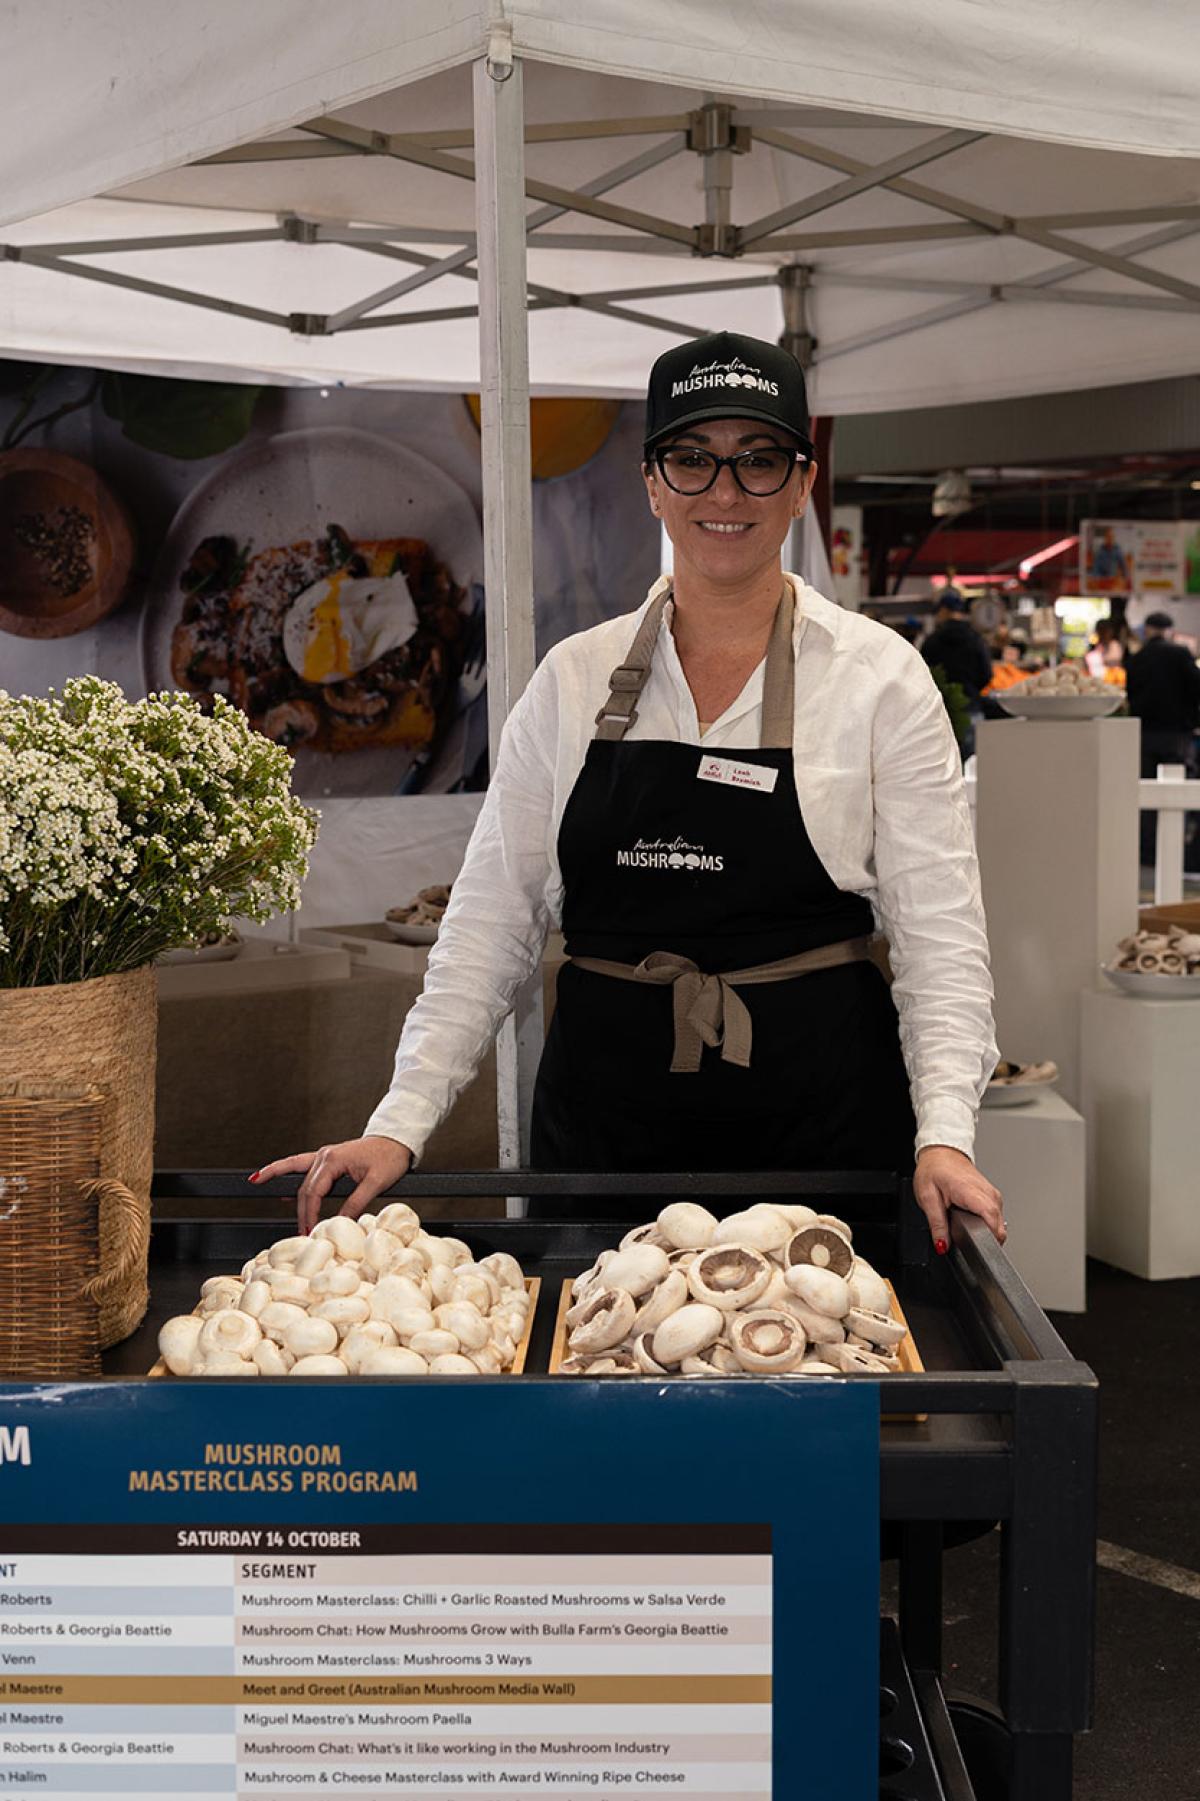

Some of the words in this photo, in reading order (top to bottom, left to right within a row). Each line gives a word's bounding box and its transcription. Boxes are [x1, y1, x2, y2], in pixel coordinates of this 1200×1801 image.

[205, 1444, 341, 1465] MUSHROOM
[129, 1470, 293, 1492] MASTERCLASS
[301, 1471, 418, 1492] PROGRAM
[177, 1530, 261, 1547] SATURDAY
[266, 1531, 283, 1547] 14
[288, 1531, 361, 1547] OCTOBER
[241, 1563, 317, 1579] SEGMENT
[0, 1593, 53, 1607] Roberts
[241, 1594, 314, 1607] Mushroom
[316, 1594, 400, 1607] Masterclass:
[402, 1593, 438, 1606] Chilli
[450, 1593, 491, 1606] Garlic
[493, 1593, 549, 1606] Roasted
[551, 1593, 631, 1606] Mushrooms
[633, 1596, 645, 1606] w
[647, 1593, 684, 1606] Salsa
[686, 1593, 726, 1606] Verde
[0, 1623, 53, 1636] Roberts
[55, 1623, 66, 1636] &
[68, 1623, 122, 1638] Georgia
[124, 1624, 173, 1636] Beattie
[241, 1624, 314, 1637] Mushroom
[316, 1624, 353, 1637] Chat:
[356, 1624, 387, 1637] How
[389, 1623, 468, 1636] Mushrooms
[470, 1623, 508, 1636] Grow
[509, 1623, 540, 1636] with
[542, 1623, 576, 1636] Bulla
[623, 1623, 678, 1638] Georgia
[680, 1623, 729, 1636] Beattie
[1, 1653, 36, 1665] Venn
[242, 1653, 315, 1666] Mushroom
[316, 1653, 400, 1666] Masterclass:
[403, 1653, 482, 1666] Mushrooms
[485, 1653, 494, 1666] 3
[496, 1653, 533, 1668] Ways
[9, 1683, 63, 1695] Maestre
[243, 1683, 276, 1695] Meet
[280, 1684, 305, 1695] and
[307, 1684, 345, 1696] Greet
[348, 1683, 421, 1697] (Australian
[424, 1683, 495, 1695] Mushroom
[498, 1683, 540, 1695] Media
[542, 1683, 576, 1696] Wall)
[9, 1712, 64, 1725] Maestre
[243, 1713, 289, 1727] Miguel
[357, 1712, 430, 1726] Mushroom
[432, 1712, 472, 1725] Paella
[3, 1741, 56, 1753] Roberts
[57, 1742, 68, 1753] &
[70, 1741, 125, 1756] Georgia
[127, 1742, 175, 1754] Beattie
[244, 1742, 315, 1754] Mushroom
[317, 1742, 354, 1755] Chat:
[404, 1742, 414, 1755] it
[416, 1742, 440, 1755] like
[442, 1742, 497, 1757] working
[499, 1742, 513, 1754] in
[514, 1742, 538, 1754] the
[540, 1741, 612, 1754] Mushroom
[614, 1741, 671, 1756] Industry
[8, 1771, 47, 1783] Halim
[244, 1771, 316, 1783] Mushroom
[318, 1771, 328, 1784] &
[331, 1771, 382, 1784] Cheese
[385, 1771, 464, 1784] Masterclass
[466, 1771, 496, 1783] with
[498, 1771, 541, 1783] Award
[543, 1771, 600, 1786] Winning
[602, 1770, 633, 1785] Ripe
[634, 1770, 686, 1783] Cheese
